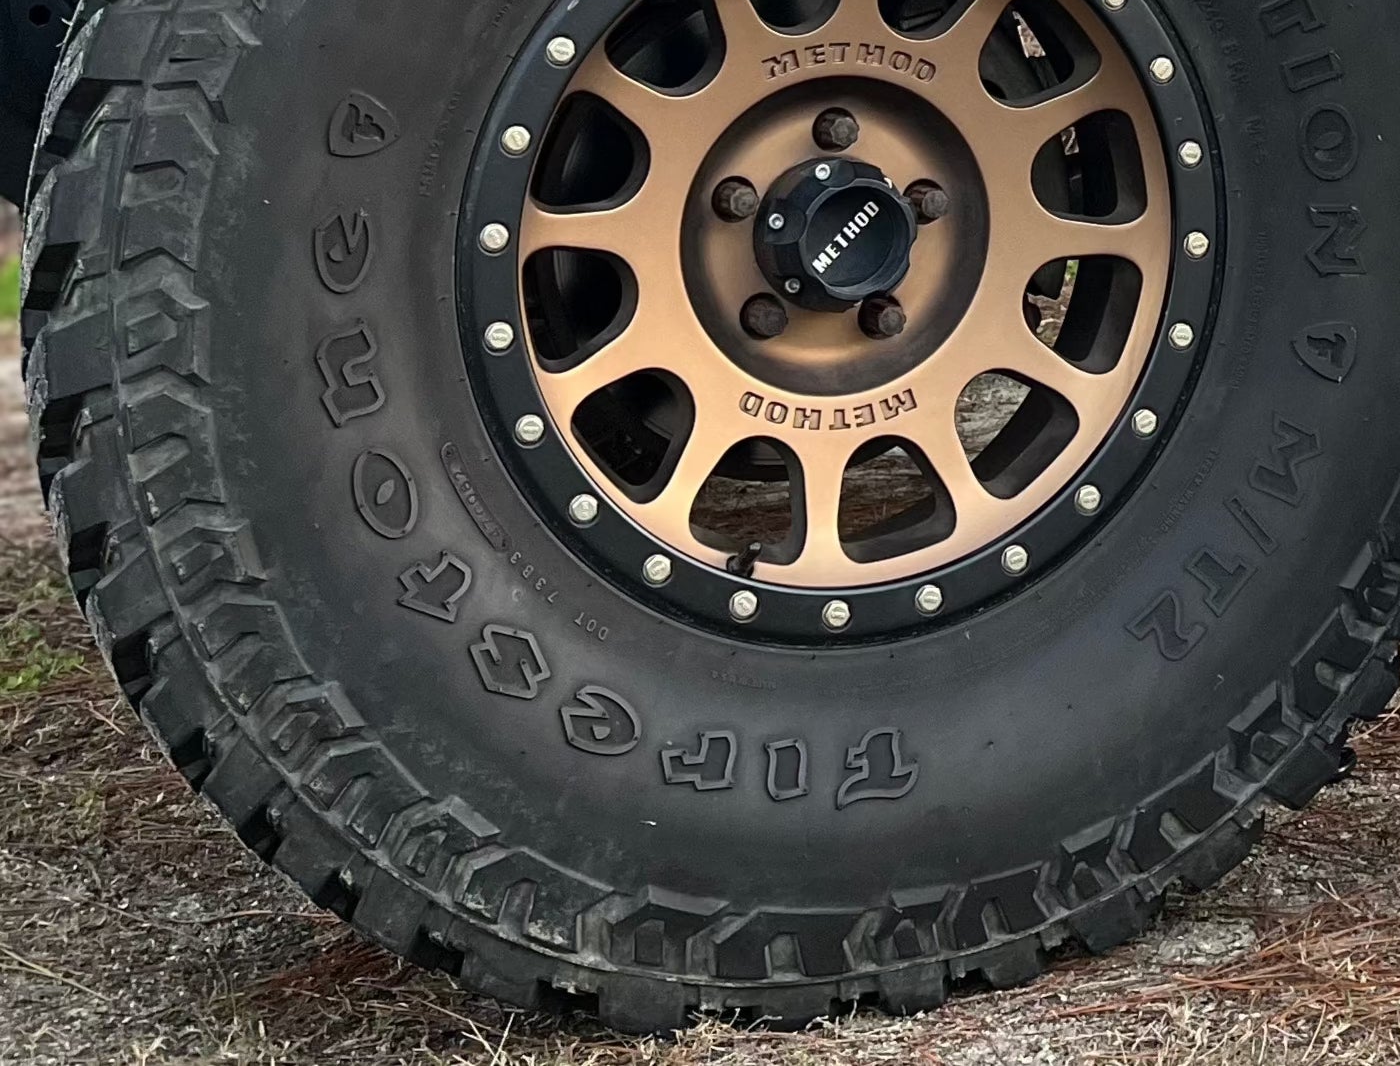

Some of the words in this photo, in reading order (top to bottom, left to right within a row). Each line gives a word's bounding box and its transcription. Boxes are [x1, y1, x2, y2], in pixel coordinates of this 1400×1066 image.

[761, 43, 937, 83] METHOD
[812, 201, 880, 274] METHOD
[739, 389, 917, 430] METHOD
[1125, 412, 1324, 661] M/T2
[574, 612, 609, 641] DOT
